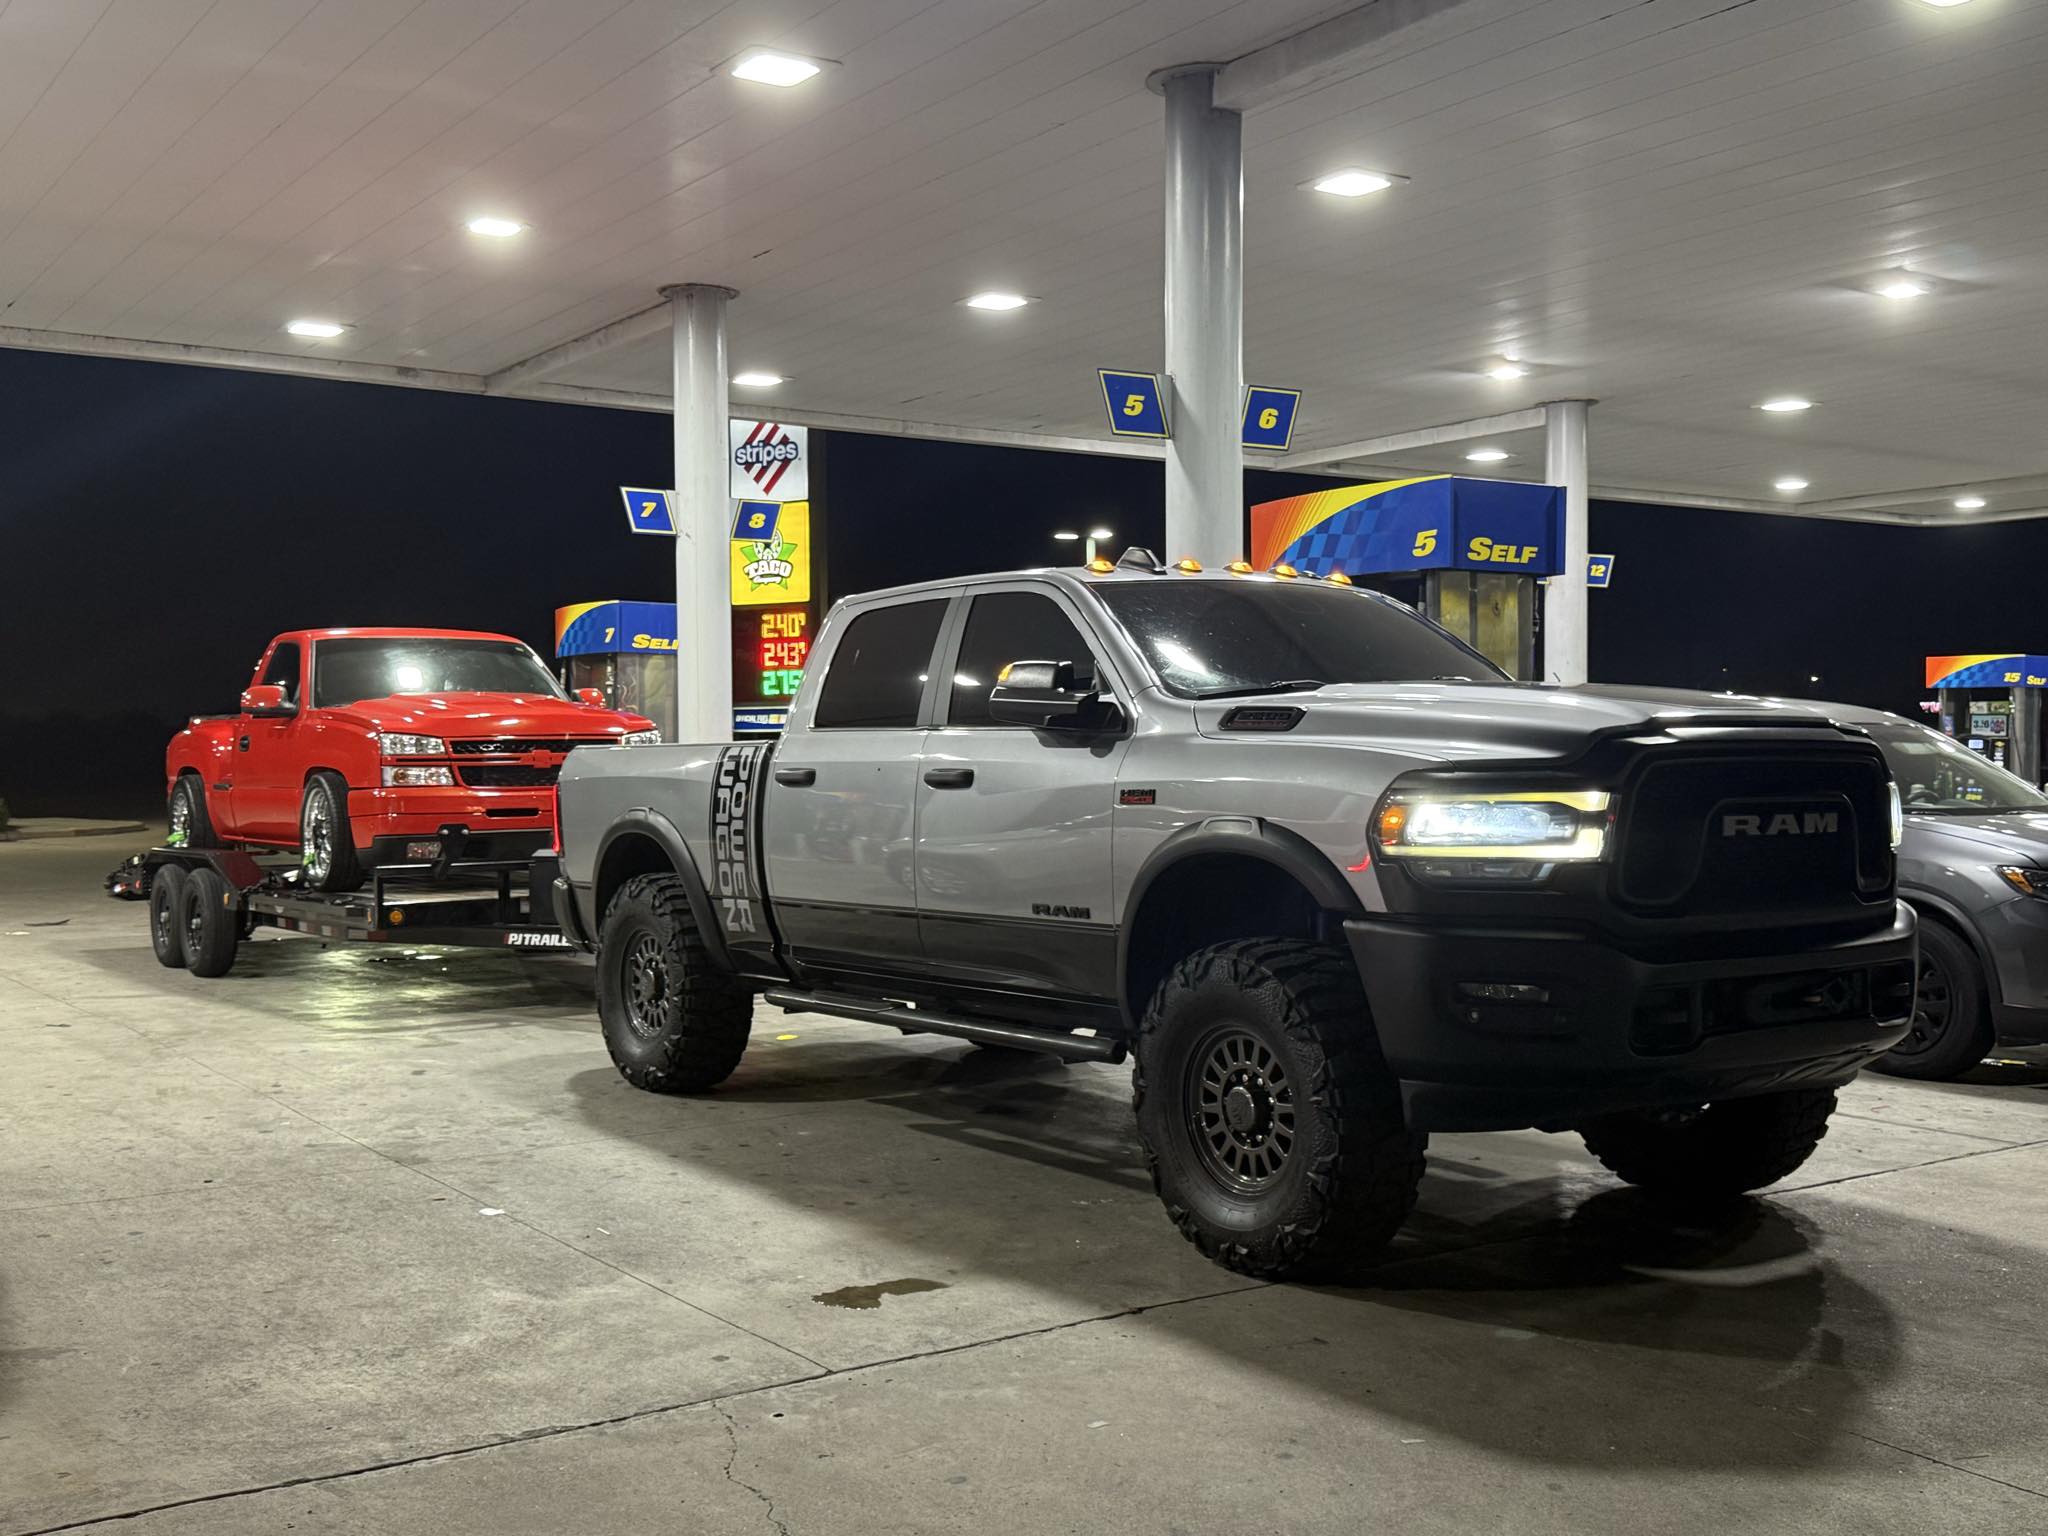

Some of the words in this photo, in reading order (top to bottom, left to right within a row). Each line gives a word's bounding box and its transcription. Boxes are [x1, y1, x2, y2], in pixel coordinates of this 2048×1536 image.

[1123, 394, 1145, 416] 5
[1258, 407, 1279, 429] 6
[735, 441, 798, 467] stripes
[640, 502, 657, 518] 7
[748, 512, 766, 529] 8
[1412, 529, 1438, 557] 5
[743, 560, 793, 580] TACO
[1590, 564, 1605, 577] 12
[1722, 812, 1839, 836] RAM
[715, 746, 742, 932] WAGON
[730, 746, 756, 933] POWER
[1031, 903, 1091, 920] RAM
[523, 933, 573, 947] TRAILE
